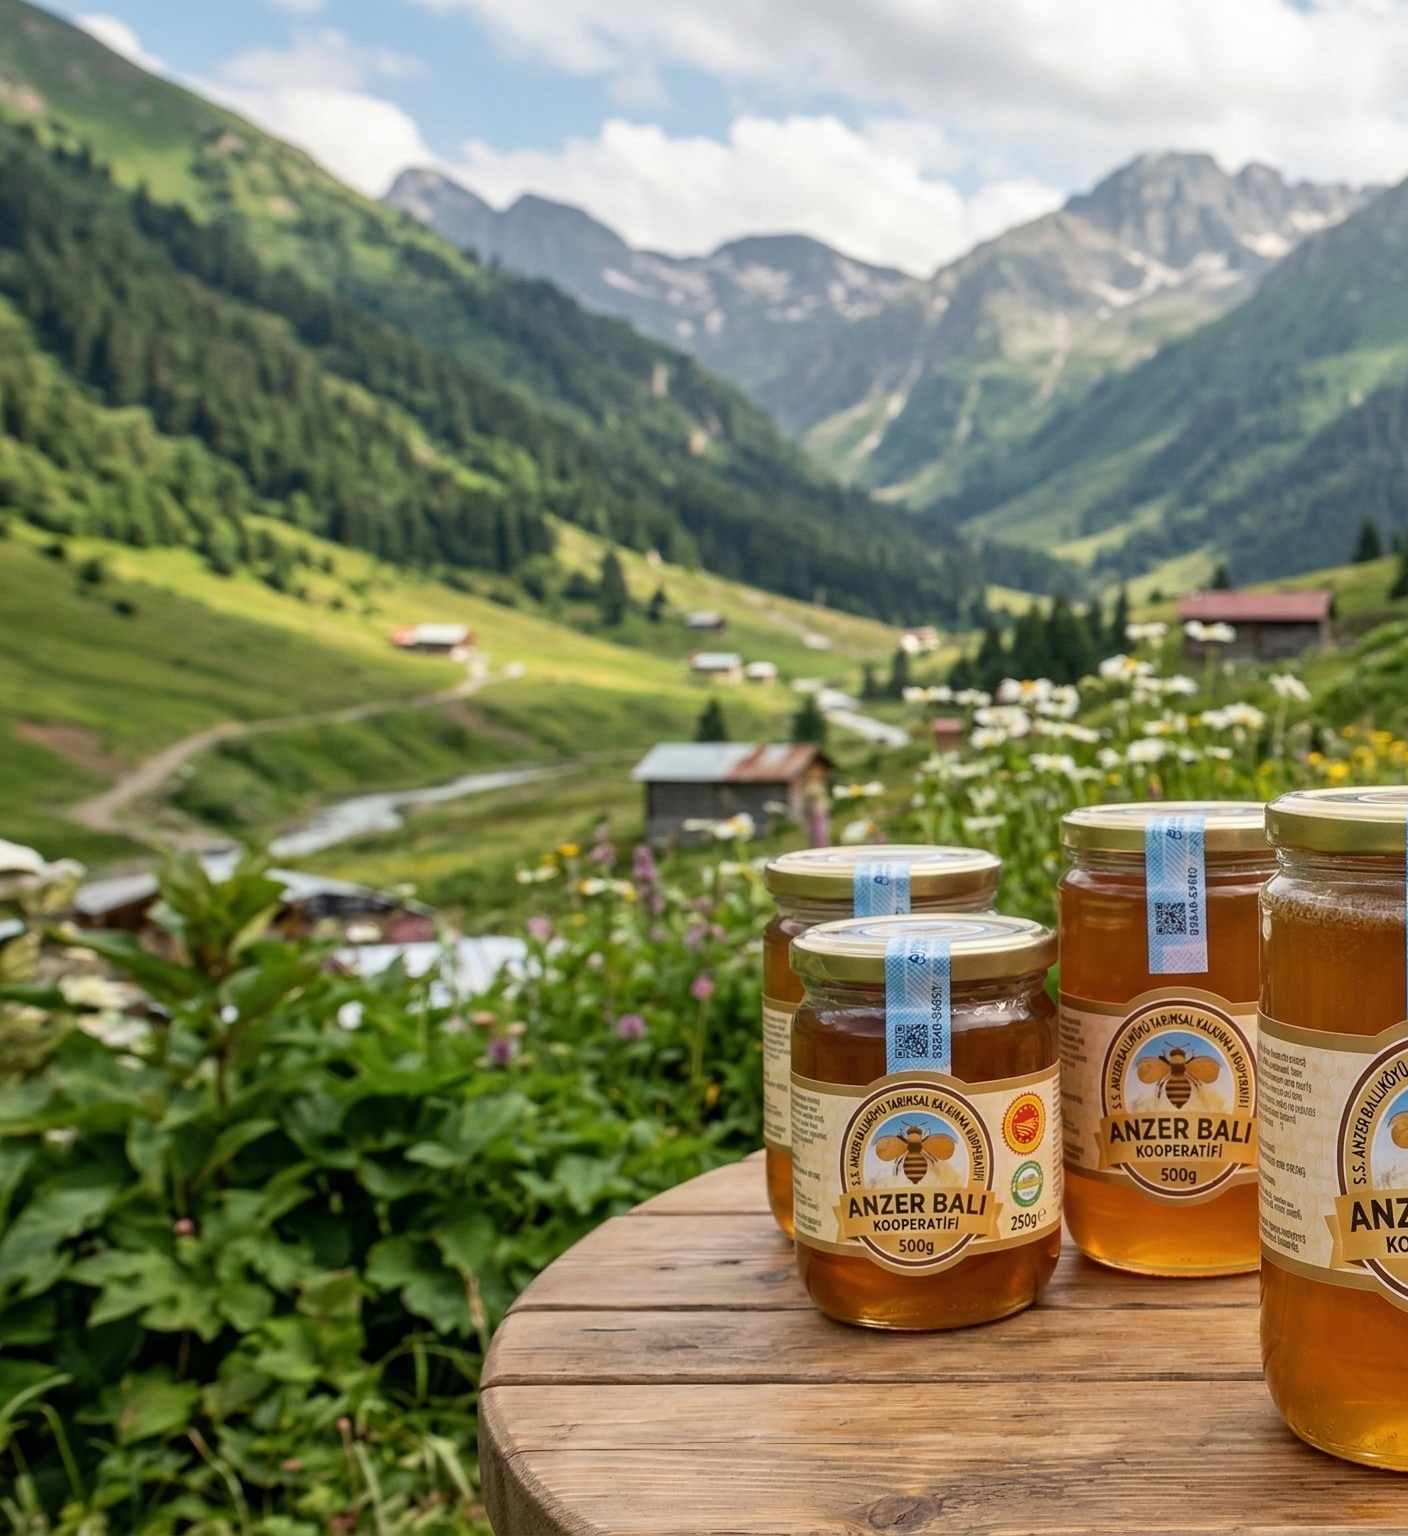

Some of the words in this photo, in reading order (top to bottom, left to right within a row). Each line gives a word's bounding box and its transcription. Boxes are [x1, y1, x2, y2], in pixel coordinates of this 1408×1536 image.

[1110, 1117, 1189, 1144] ANZER
[1197, 1118, 1252, 1144] BALI
[1352, 1117, 1371, 1157] ANZER
[1161, 1167, 1197, 1184] 500g
[849, 1193, 926, 1218] ANZER
[933, 1193, 986, 1216] BALI
[899, 1239, 934, 1255] 500g
